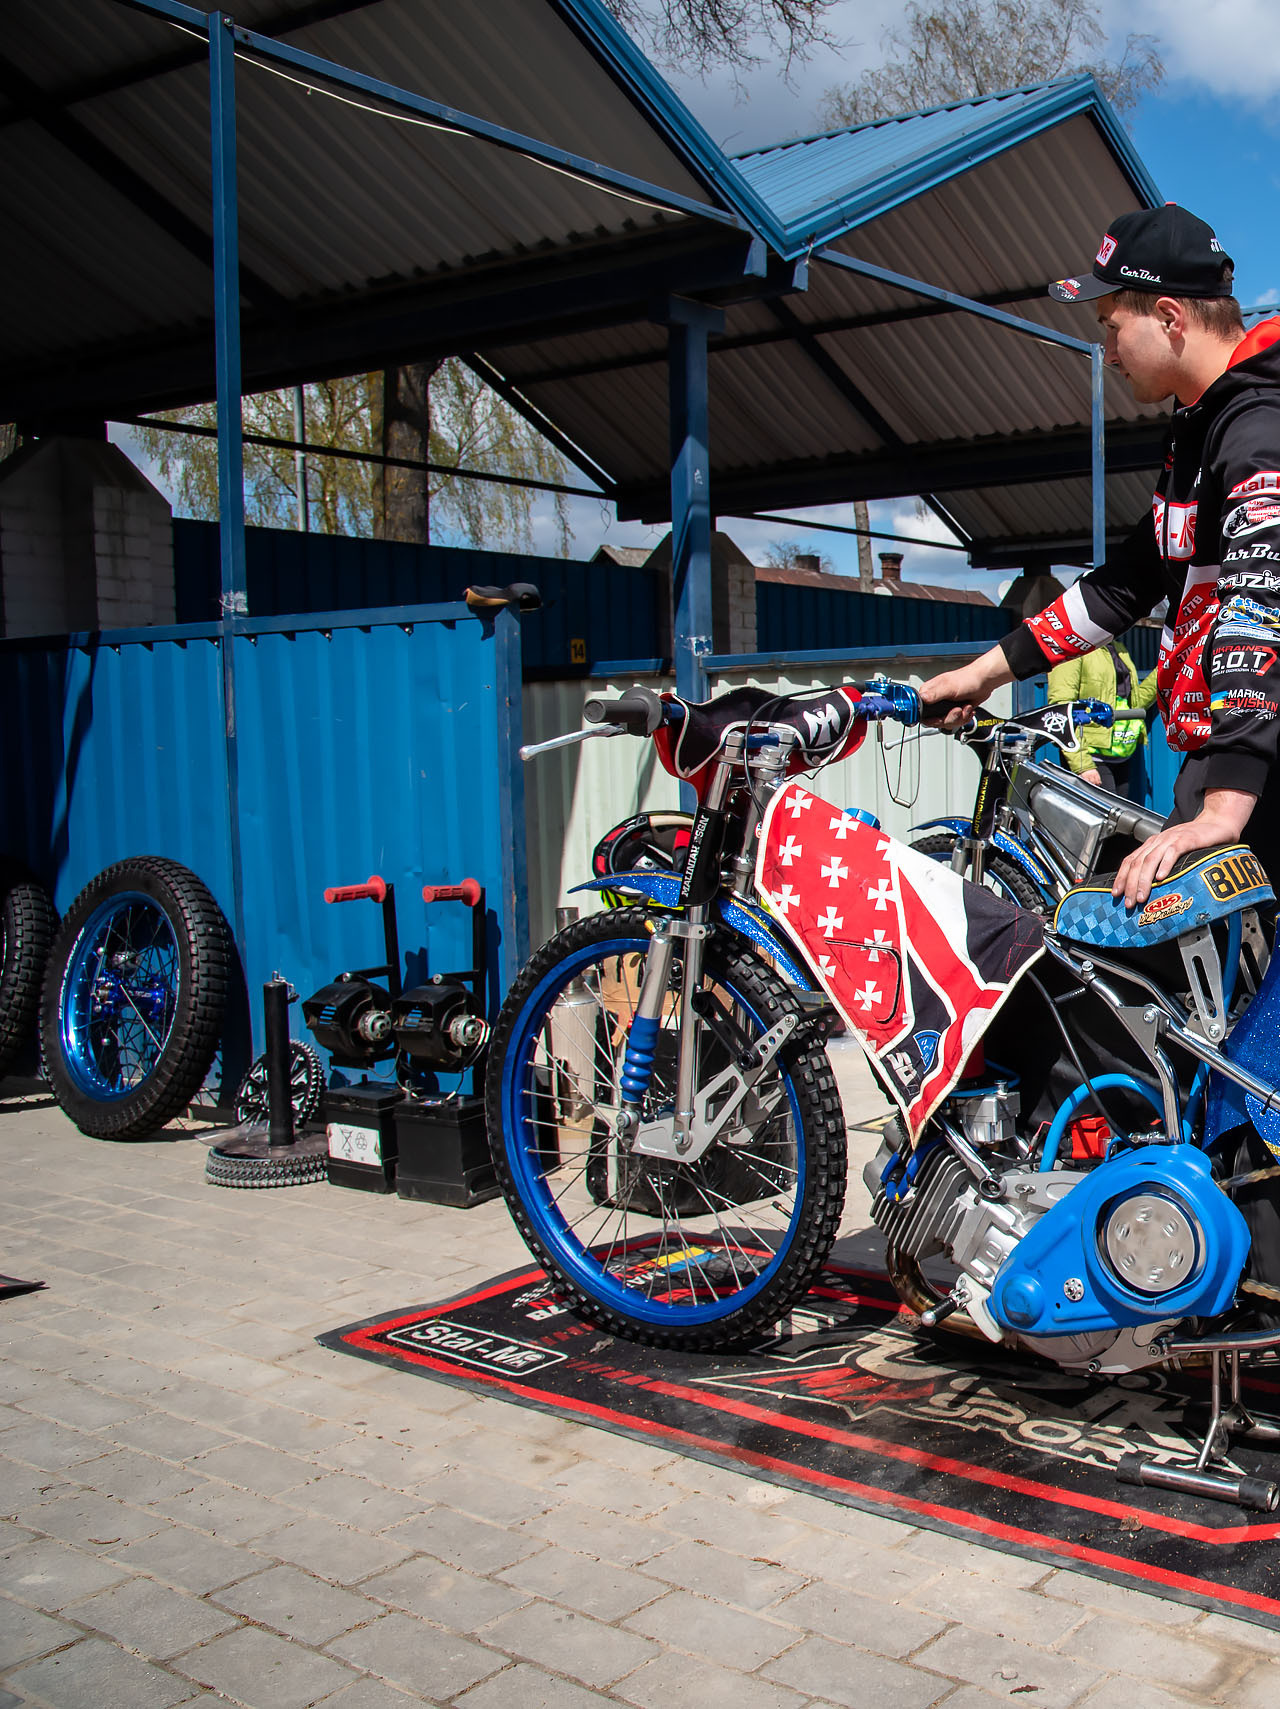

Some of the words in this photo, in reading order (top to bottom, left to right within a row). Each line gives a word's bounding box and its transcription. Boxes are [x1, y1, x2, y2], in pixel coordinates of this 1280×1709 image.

[571, 643, 585, 659] 14
[1228, 688, 1266, 700] MARKO
[1223, 698, 1279, 712] LEVISHYN
